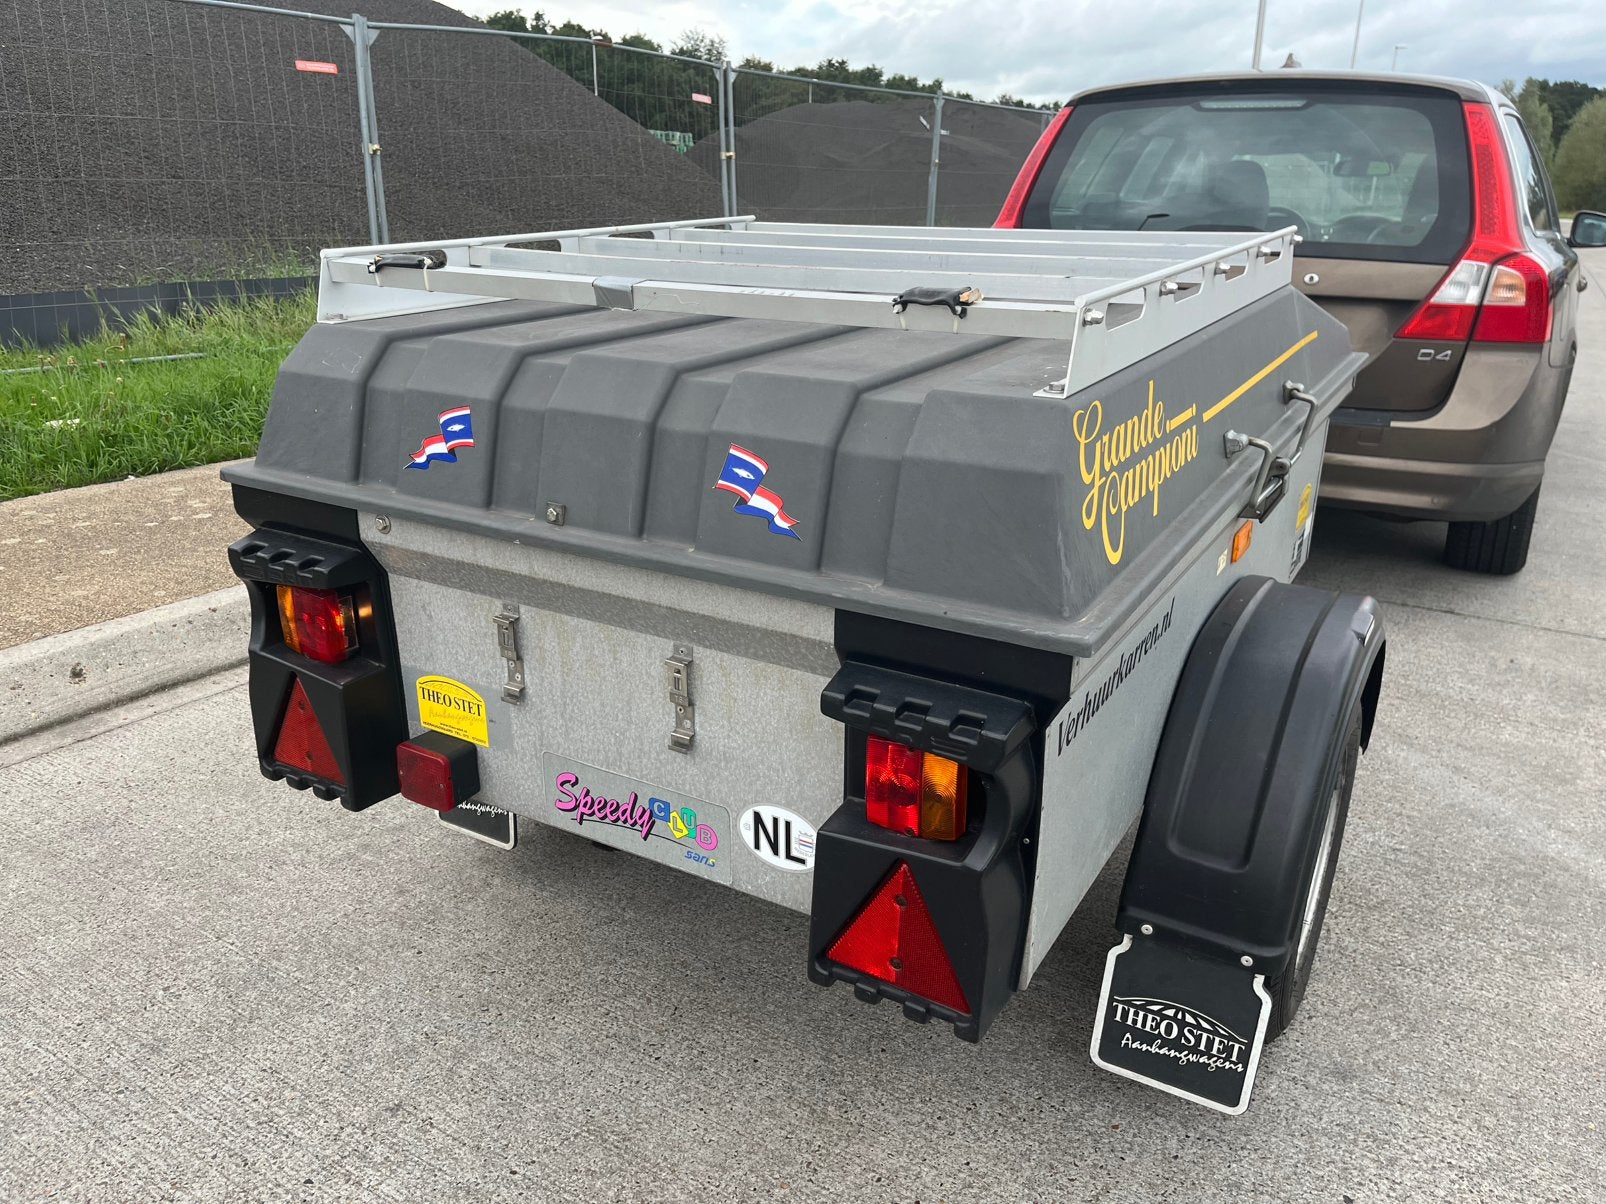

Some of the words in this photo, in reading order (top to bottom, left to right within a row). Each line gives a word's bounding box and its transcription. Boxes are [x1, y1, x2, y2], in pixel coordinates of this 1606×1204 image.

[1417, 348, 1452, 361] D4
[1073, 379, 1165, 530] Grande
[1101, 424, 1199, 565] Campioni
[419, 686, 452, 708] THEO
[453, 697, 482, 717] STET
[1057, 596, 1175, 757] Verhuurkarren.nl
[555, 772, 656, 841] Speedy
[648, 797, 718, 851] CLUB
[753, 810, 806, 866] NL
[684, 850, 716, 868] saris
[1112, 1001, 1179, 1040] THEO
[1180, 1026, 1246, 1063] STET
[1120, 1032, 1244, 1073] Aanhangwagens
